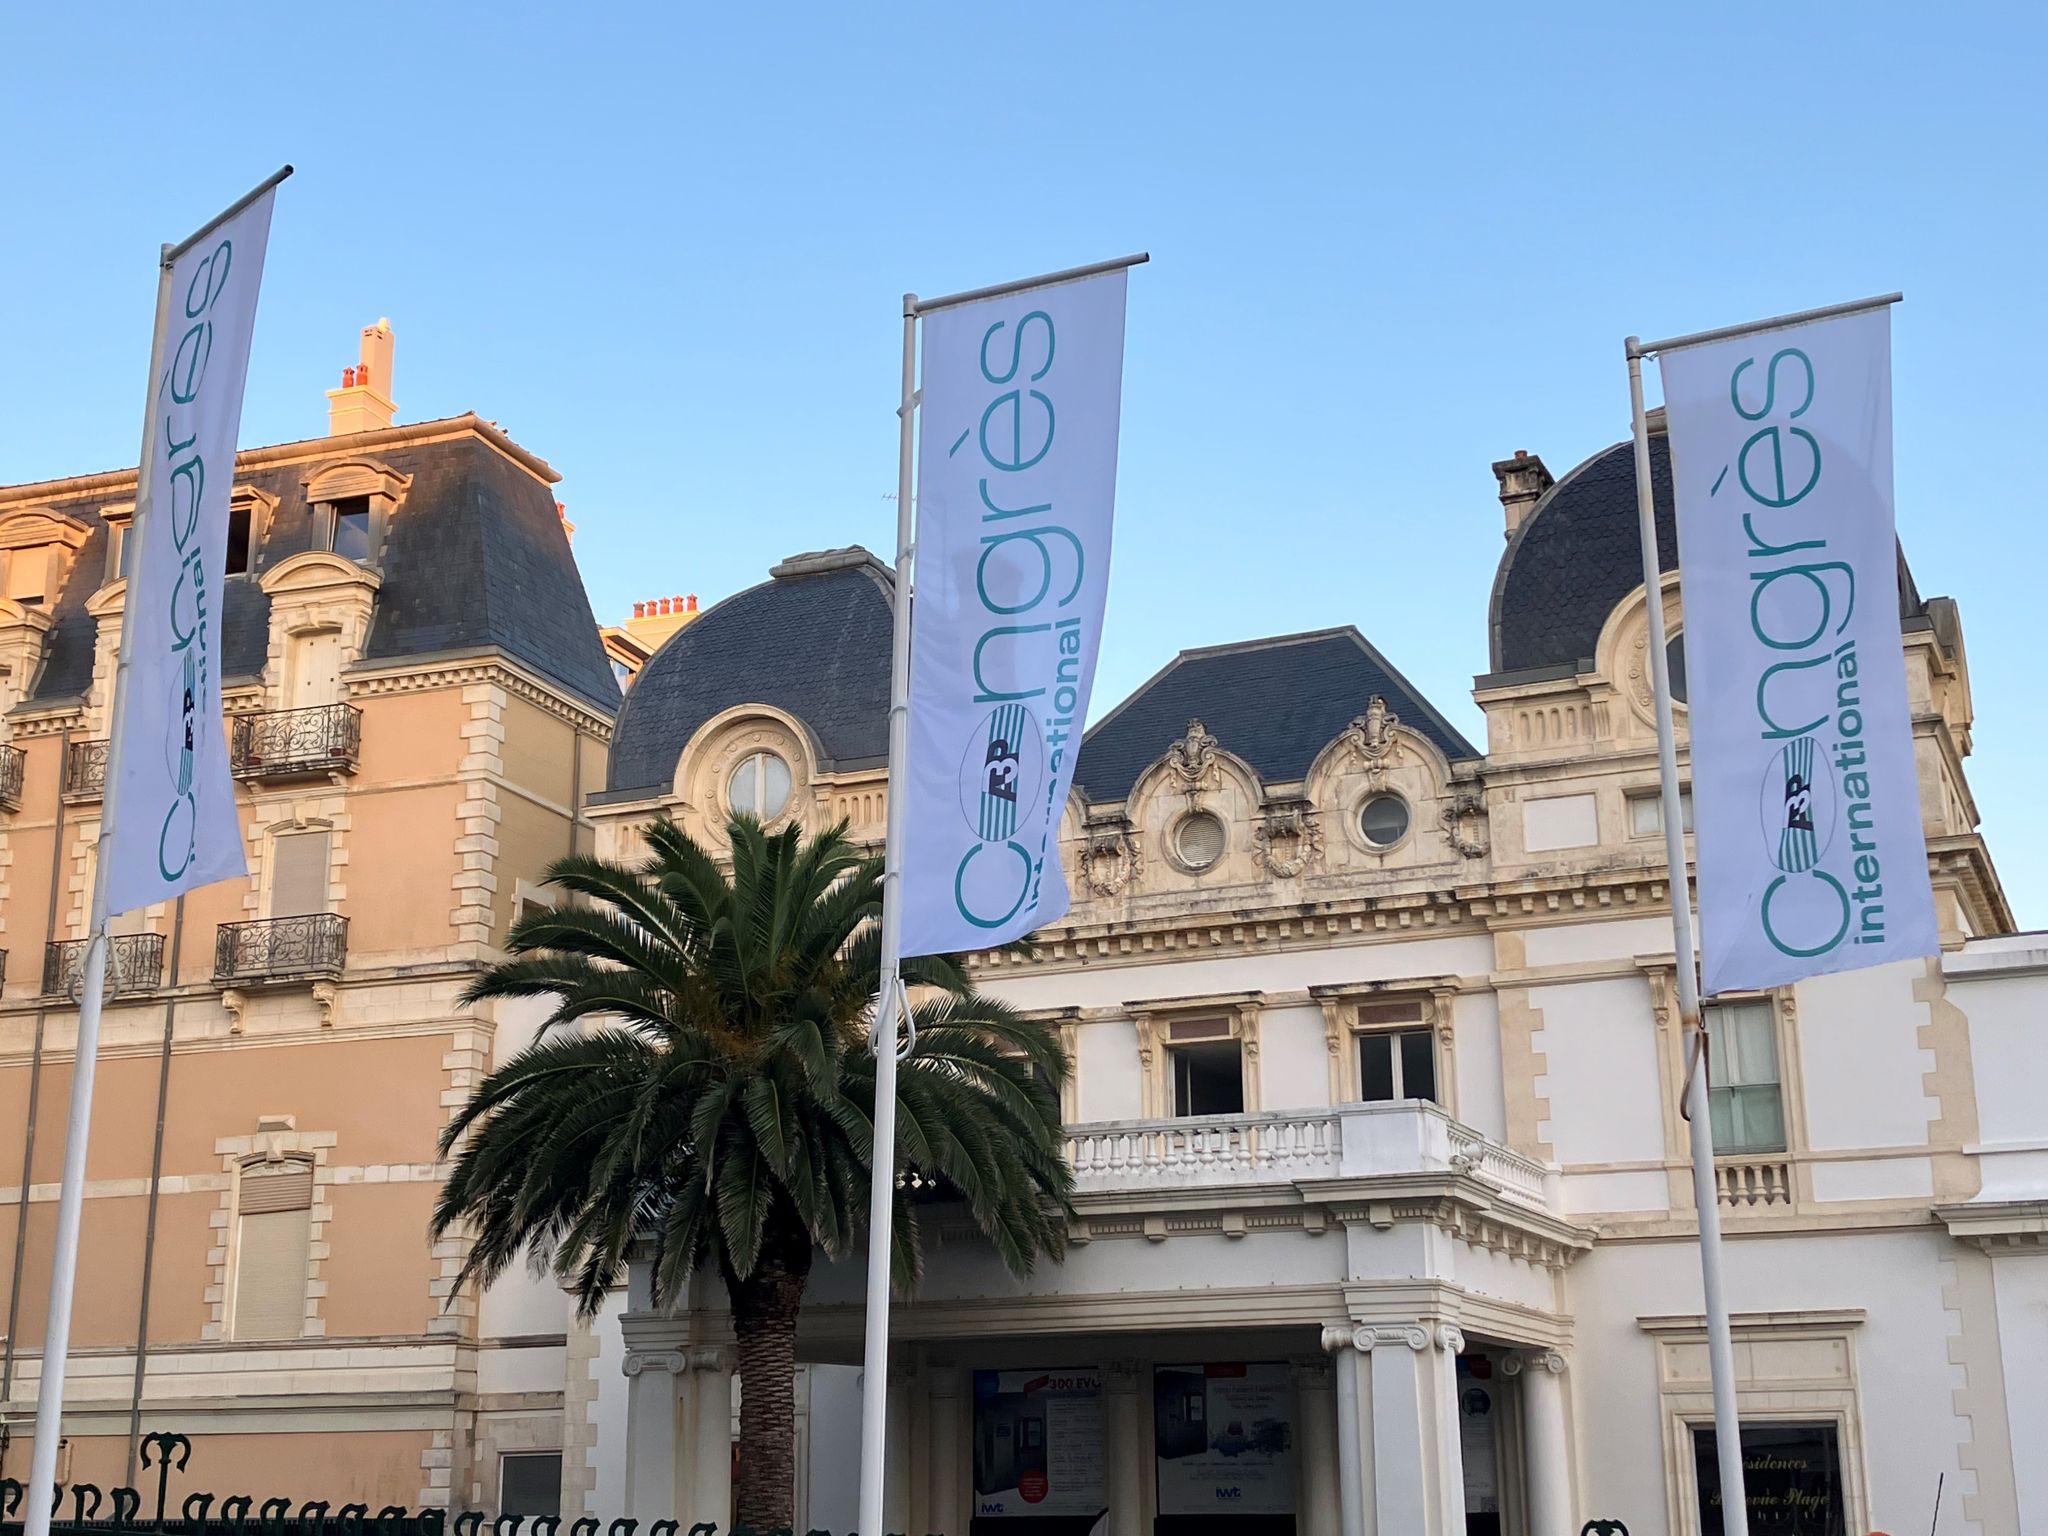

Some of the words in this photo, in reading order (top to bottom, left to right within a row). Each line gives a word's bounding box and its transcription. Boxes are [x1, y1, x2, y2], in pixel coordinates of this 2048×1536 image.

[981, 738, 1020, 803] A3P
[1833, 640, 1885, 944] international
[1782, 774, 1814, 831] A3P
[1743, 1454, 1809, 1470] ésidences
